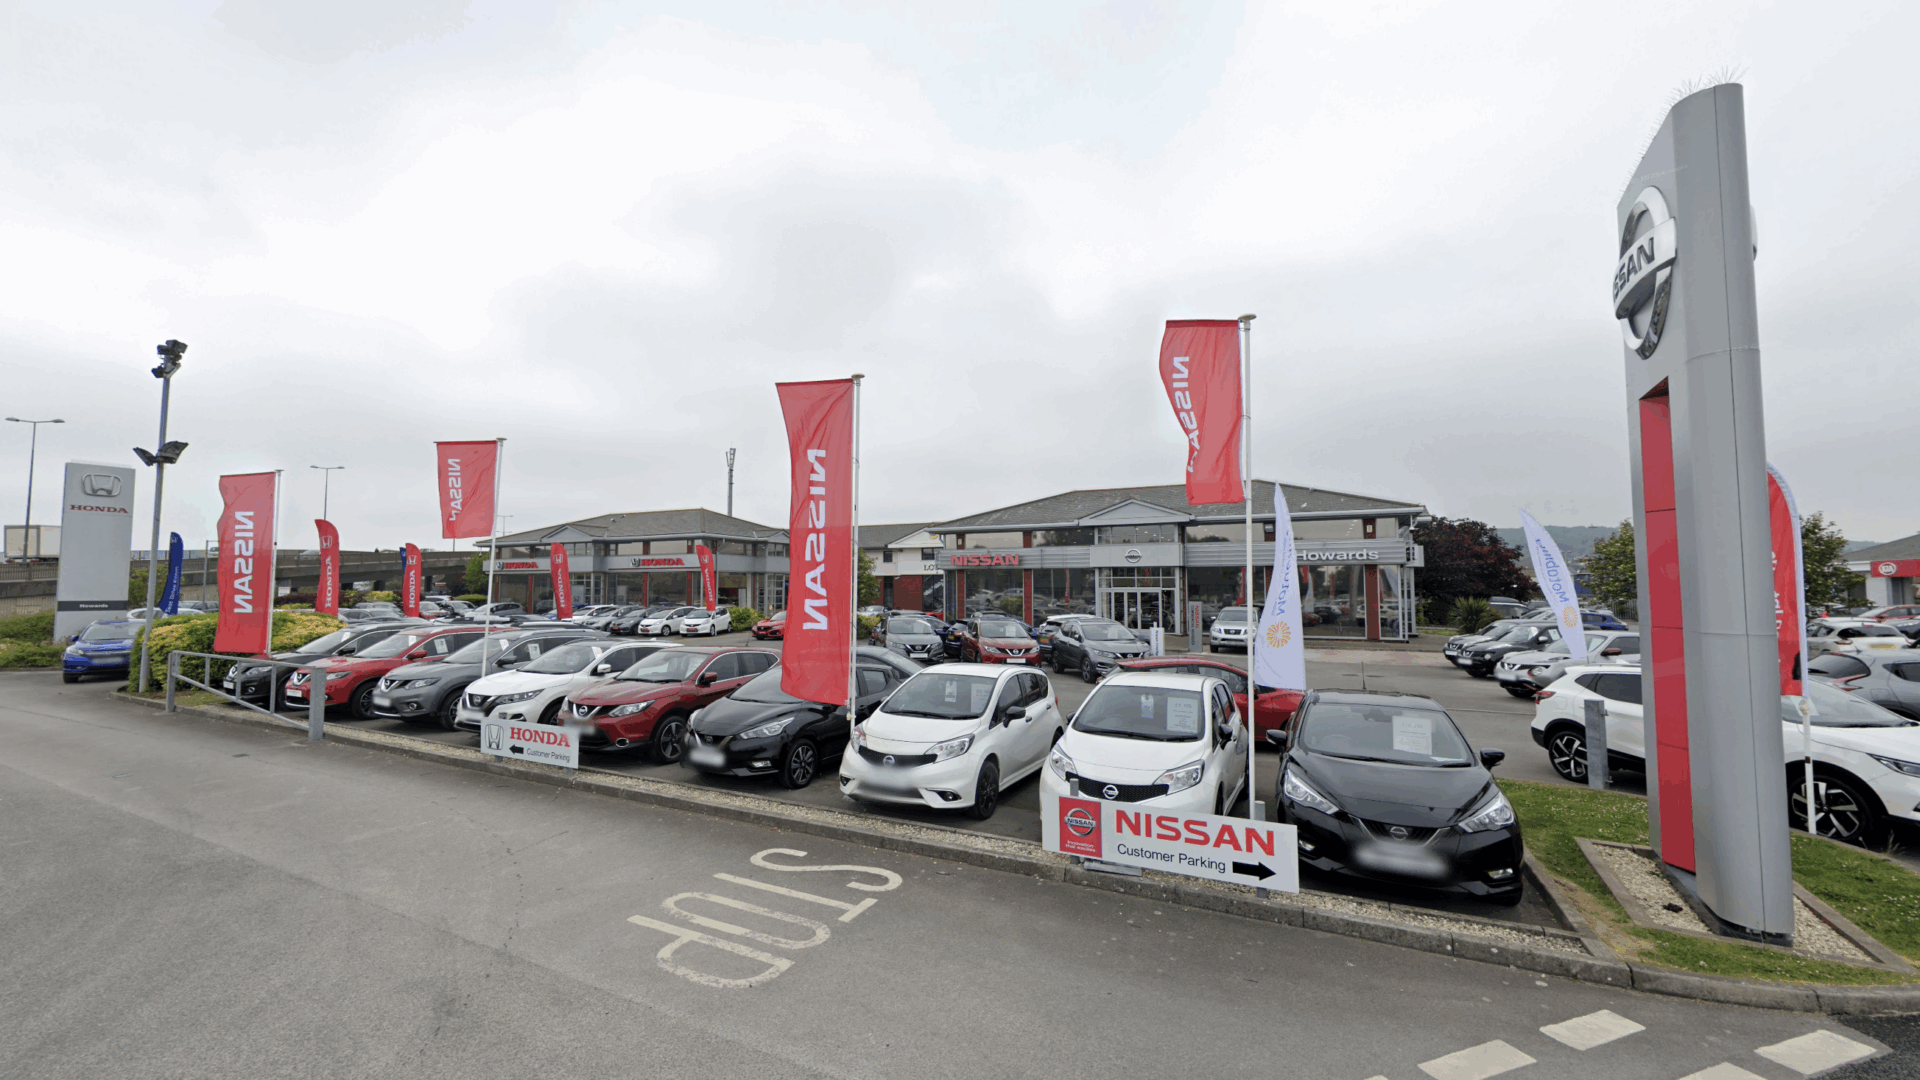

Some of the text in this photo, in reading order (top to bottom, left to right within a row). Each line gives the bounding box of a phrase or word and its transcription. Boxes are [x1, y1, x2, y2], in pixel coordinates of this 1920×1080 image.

[70, 504, 128, 513] HONDA
[951, 554, 1019, 566] NISSAN
[1295, 548, 1379, 561] Howards
[504, 561, 538, 569] HONDA
[641, 558, 685, 566] HONDA
[324, 555, 333, 608] HONDA
[555, 568, 566, 608] HONDA
[510, 727, 570, 747] HONDA
[527, 748, 570, 763] Customer Parking
[1067, 818, 1093, 826] NISSAN
[1116, 809, 1275, 857] NISSAN
[1067, 840, 1094, 848] Innovation
[1117, 843, 1226, 873] Customer Parking
[626, 848, 903, 989] STOP
